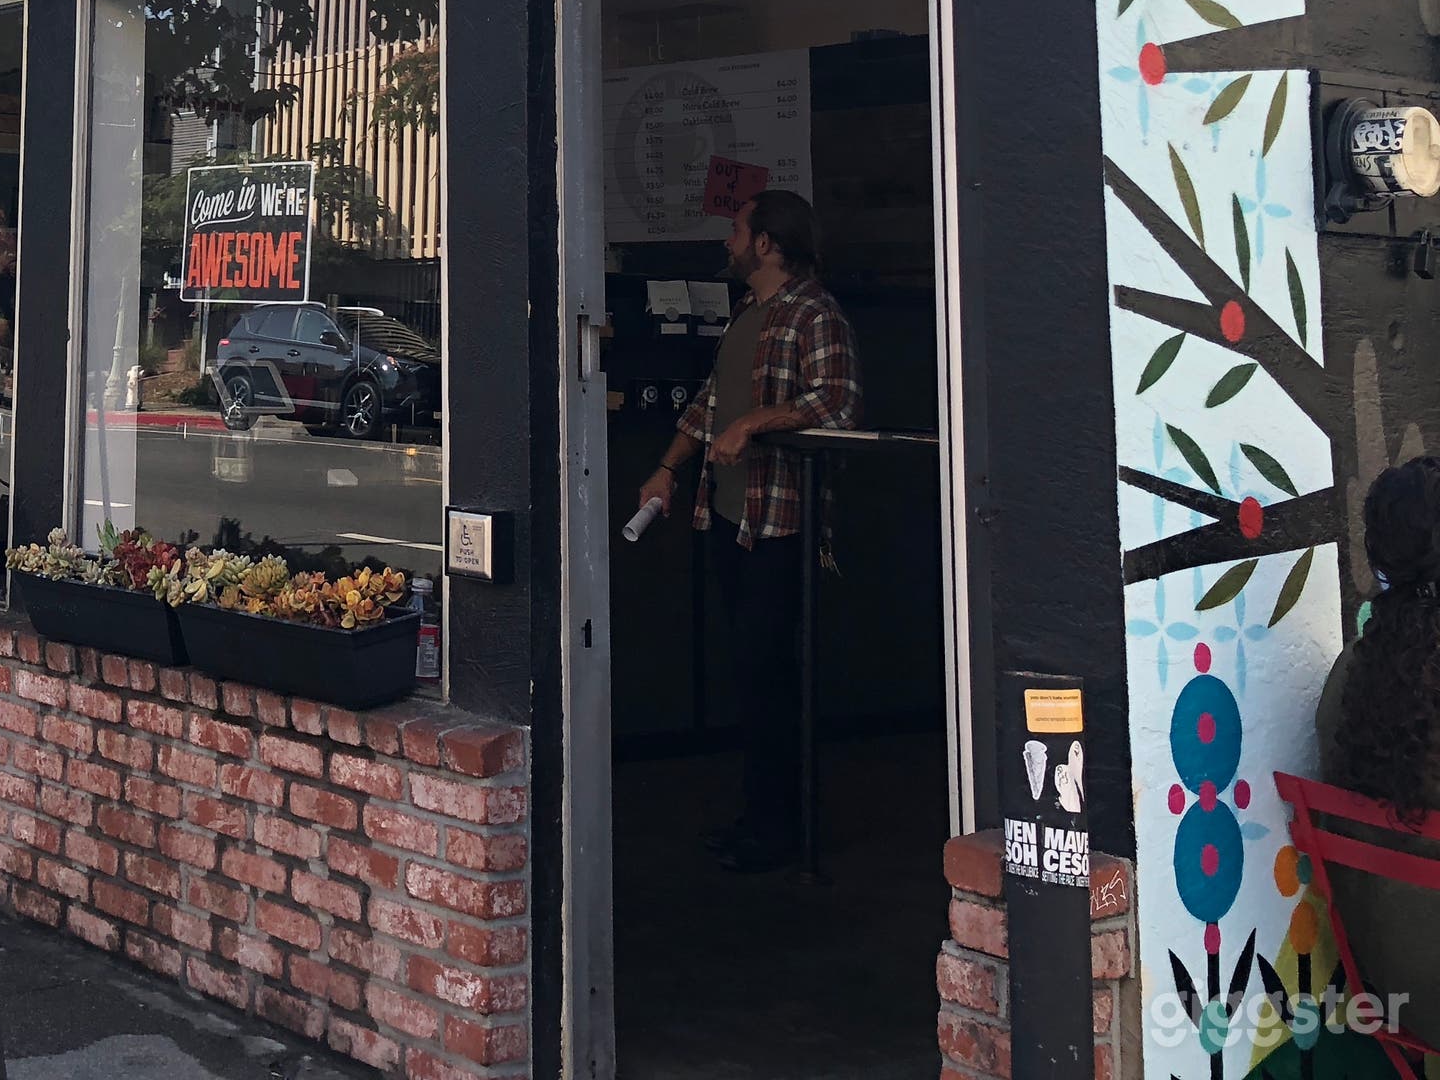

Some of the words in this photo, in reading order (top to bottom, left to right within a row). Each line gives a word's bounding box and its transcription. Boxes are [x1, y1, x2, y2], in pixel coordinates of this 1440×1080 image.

[715, 162, 744, 181] OUT
[191, 189, 234, 226] Come
[237, 178, 256, 213] in
[261, 182, 304, 217] WE'RE
[187, 231, 302, 290] AWESOME
[463, 557, 480, 565] OPEN
